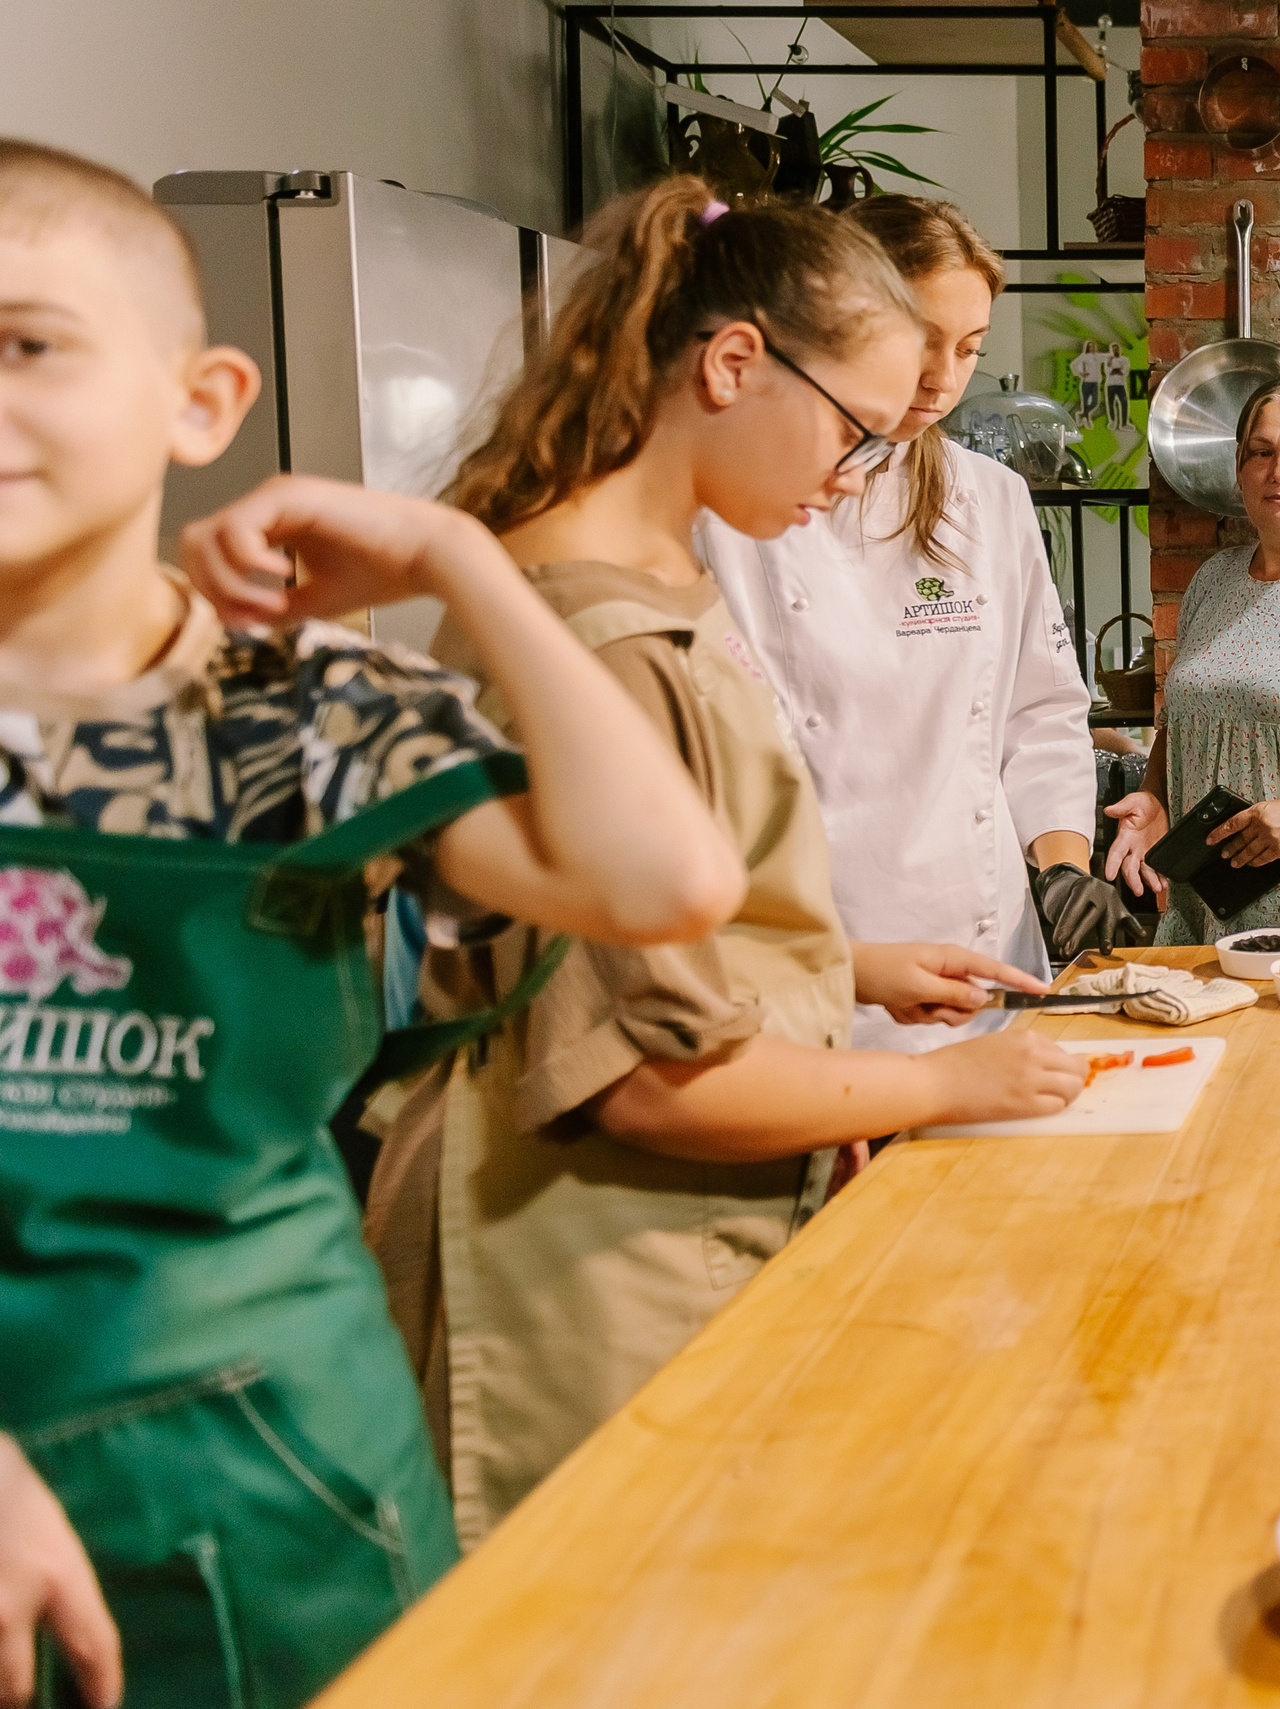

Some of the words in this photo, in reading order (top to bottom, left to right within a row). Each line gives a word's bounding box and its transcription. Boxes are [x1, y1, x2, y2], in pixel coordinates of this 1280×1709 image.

[903, 600, 974, 619] АРТИШОК
[896, 627, 931, 638] Варвара
[934, 625, 982, 634] Черданцева
